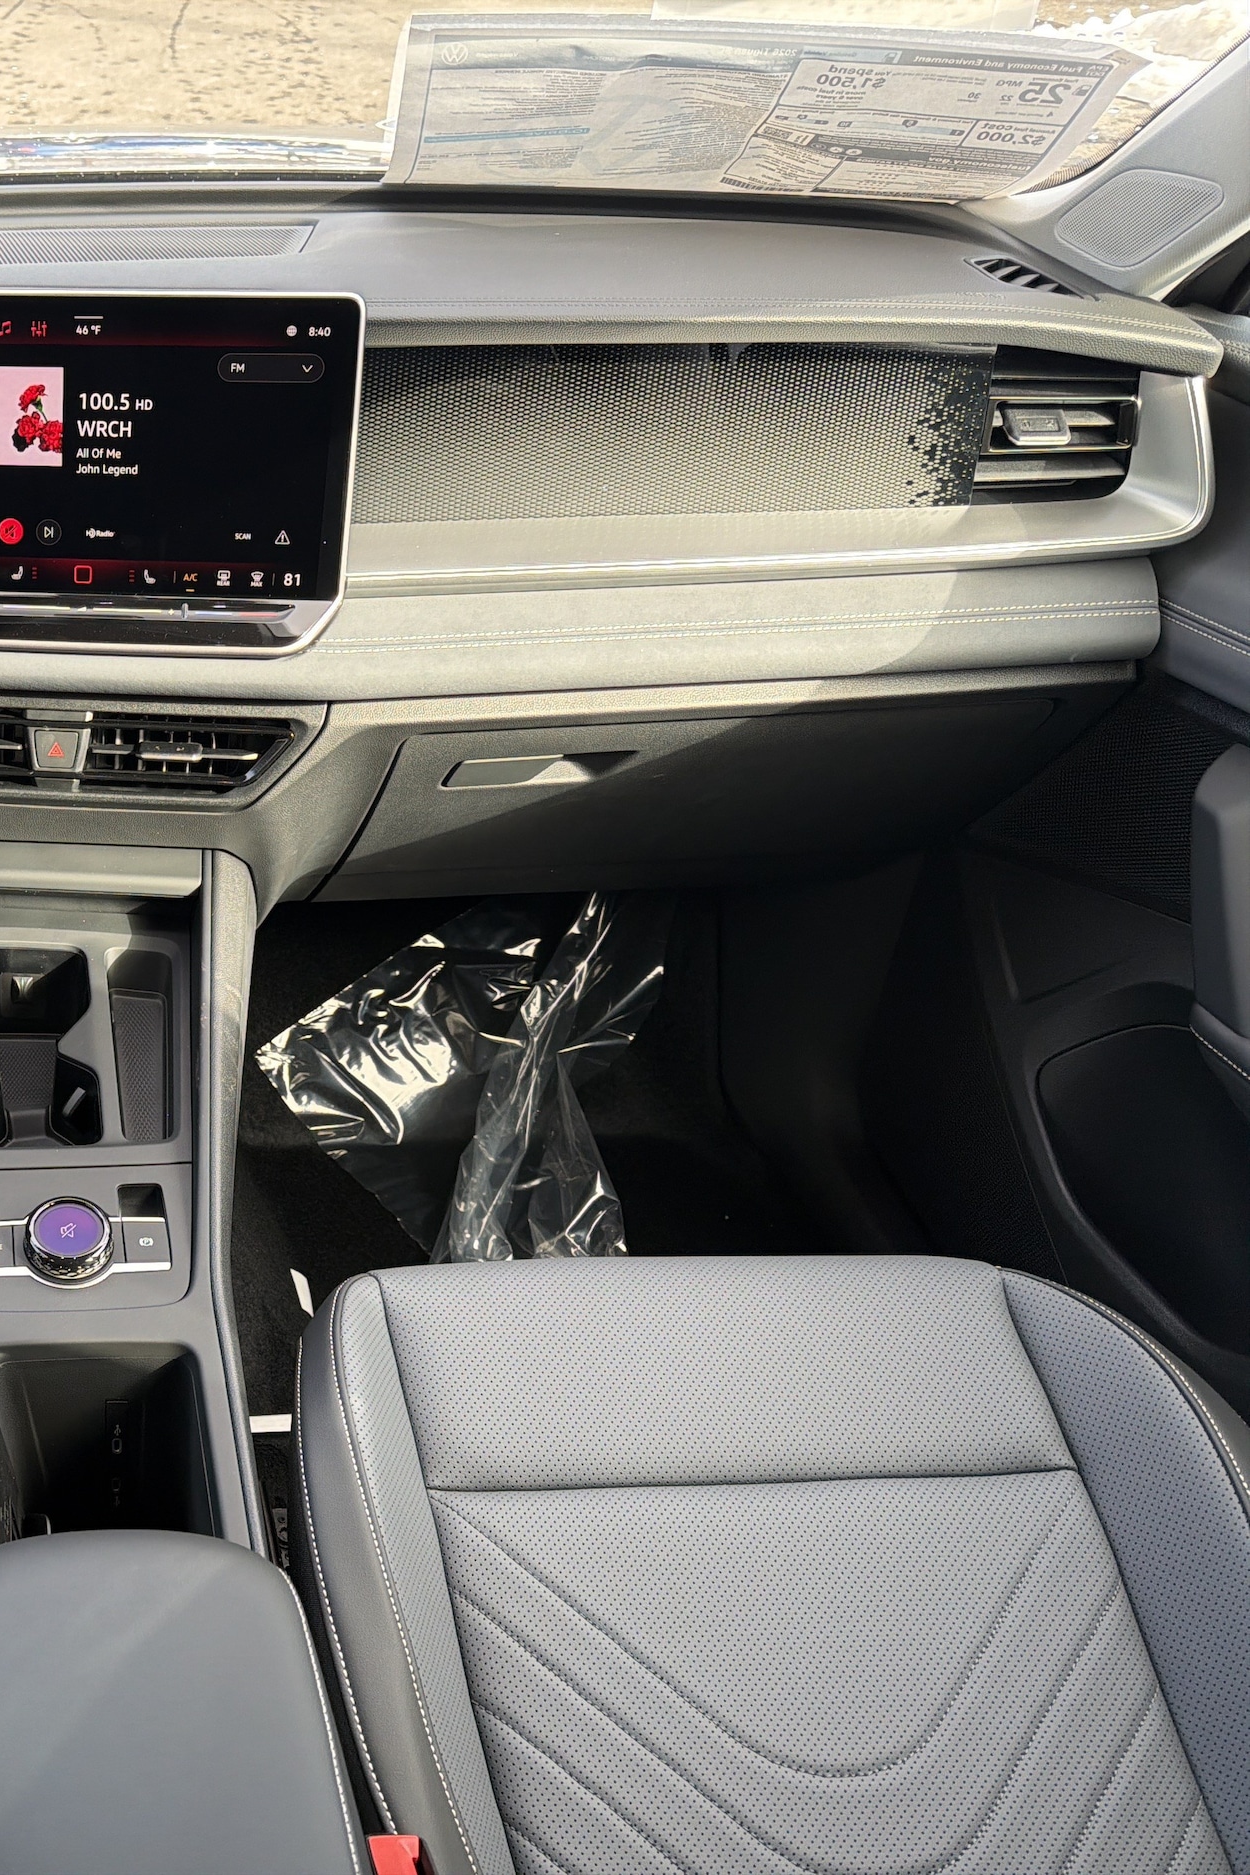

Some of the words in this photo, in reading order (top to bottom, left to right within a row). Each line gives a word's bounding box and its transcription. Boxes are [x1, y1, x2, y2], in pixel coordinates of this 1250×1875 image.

[75, 325, 89, 335] 46
[308, 326, 332, 337] 8:40
[230, 362, 246, 373] FM
[78, 392, 130, 411] 100.5
[135, 399, 154, 411] HD
[76, 420, 133, 438] WRCH
[76, 448, 89, 459] All
[91, 448, 105, 459] Of
[106, 448, 122, 459] Me
[76, 464, 100, 475] John
[102, 464, 139, 477] Legend
[234, 533, 252, 541] SCAN
[183, 573, 198, 582] A/C
[283, 573, 301, 587] 81
